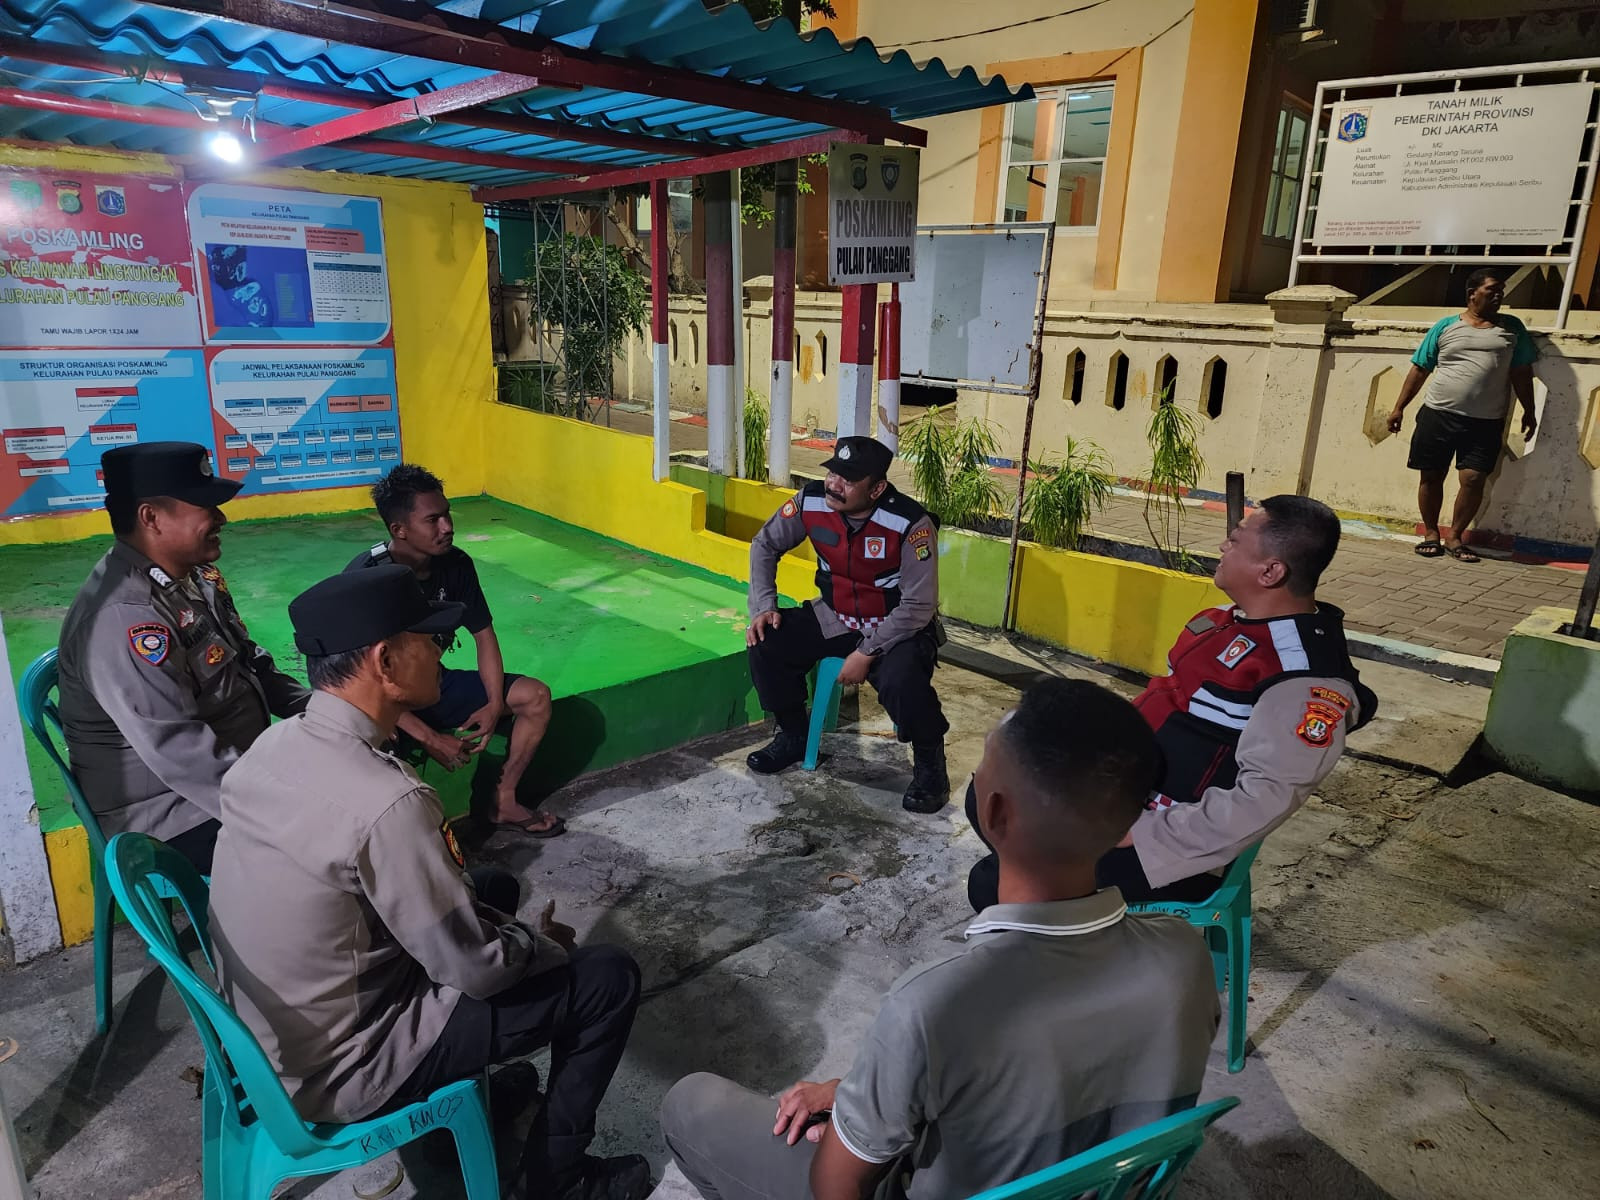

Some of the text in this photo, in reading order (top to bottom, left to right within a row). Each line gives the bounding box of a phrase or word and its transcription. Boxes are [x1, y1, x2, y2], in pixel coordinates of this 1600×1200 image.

[1428, 95, 1504, 110] TANAH MILIK
[1394, 107, 1534, 126] PEMERINTAH PROVINSI
[1421, 122, 1499, 137] DKI JAKARTA
[269, 204, 292, 213] PETA
[836, 199, 912, 239] POSKAMLING
[7, 227, 145, 250] POSKAMLING
[837, 245, 910, 275] PULAU PANGGANG
[11, 260, 89, 280] KEAMANAN
[93, 263, 179, 282] LINGKUNGAN
[68, 289, 111, 305] PULAU
[115, 291, 185, 307] PANGGANG
[20, 360, 168, 370] STRUKTUR ORGANISASI POSKAMLING
[242, 361, 365, 371] JADWAL PELAKSANAAN POSKAMLING
[33, 368, 158, 378] KELURAHAN PULAU PANGGANG
[253, 369, 356, 379] KELURAHAN PULAU PANGGANG
